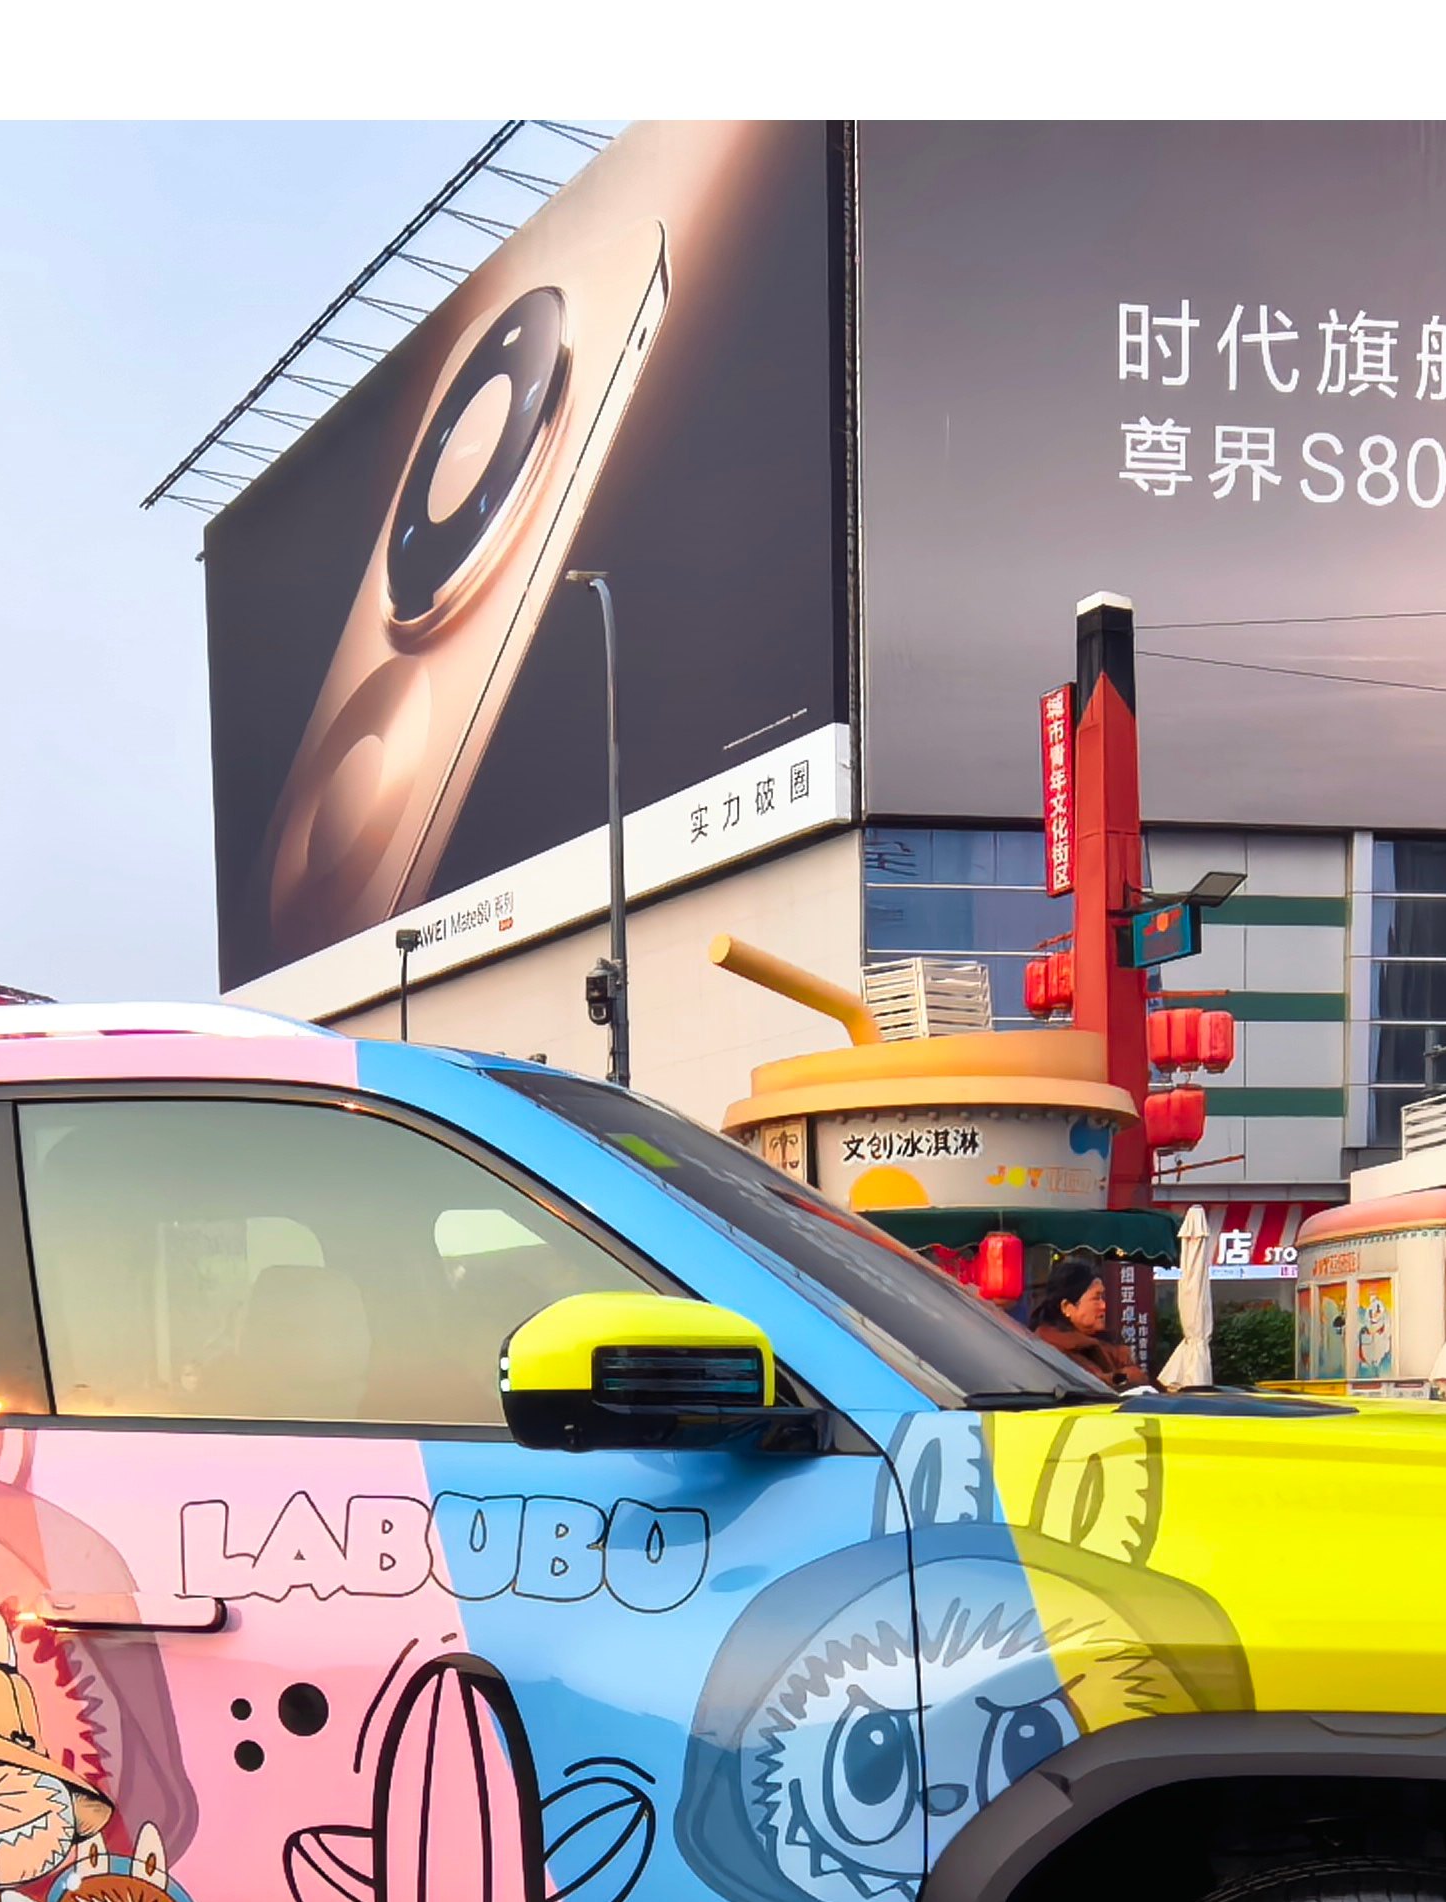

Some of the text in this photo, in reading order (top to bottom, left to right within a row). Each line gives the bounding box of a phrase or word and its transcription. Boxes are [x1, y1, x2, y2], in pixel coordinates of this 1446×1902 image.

[690, 759, 810, 844] 实力破圈
[842, 1126, 980, 1162] 文创冰淇淋
[1216, 1228, 1253, 1265] 店
[175, 1490, 710, 1613] LABUBU
